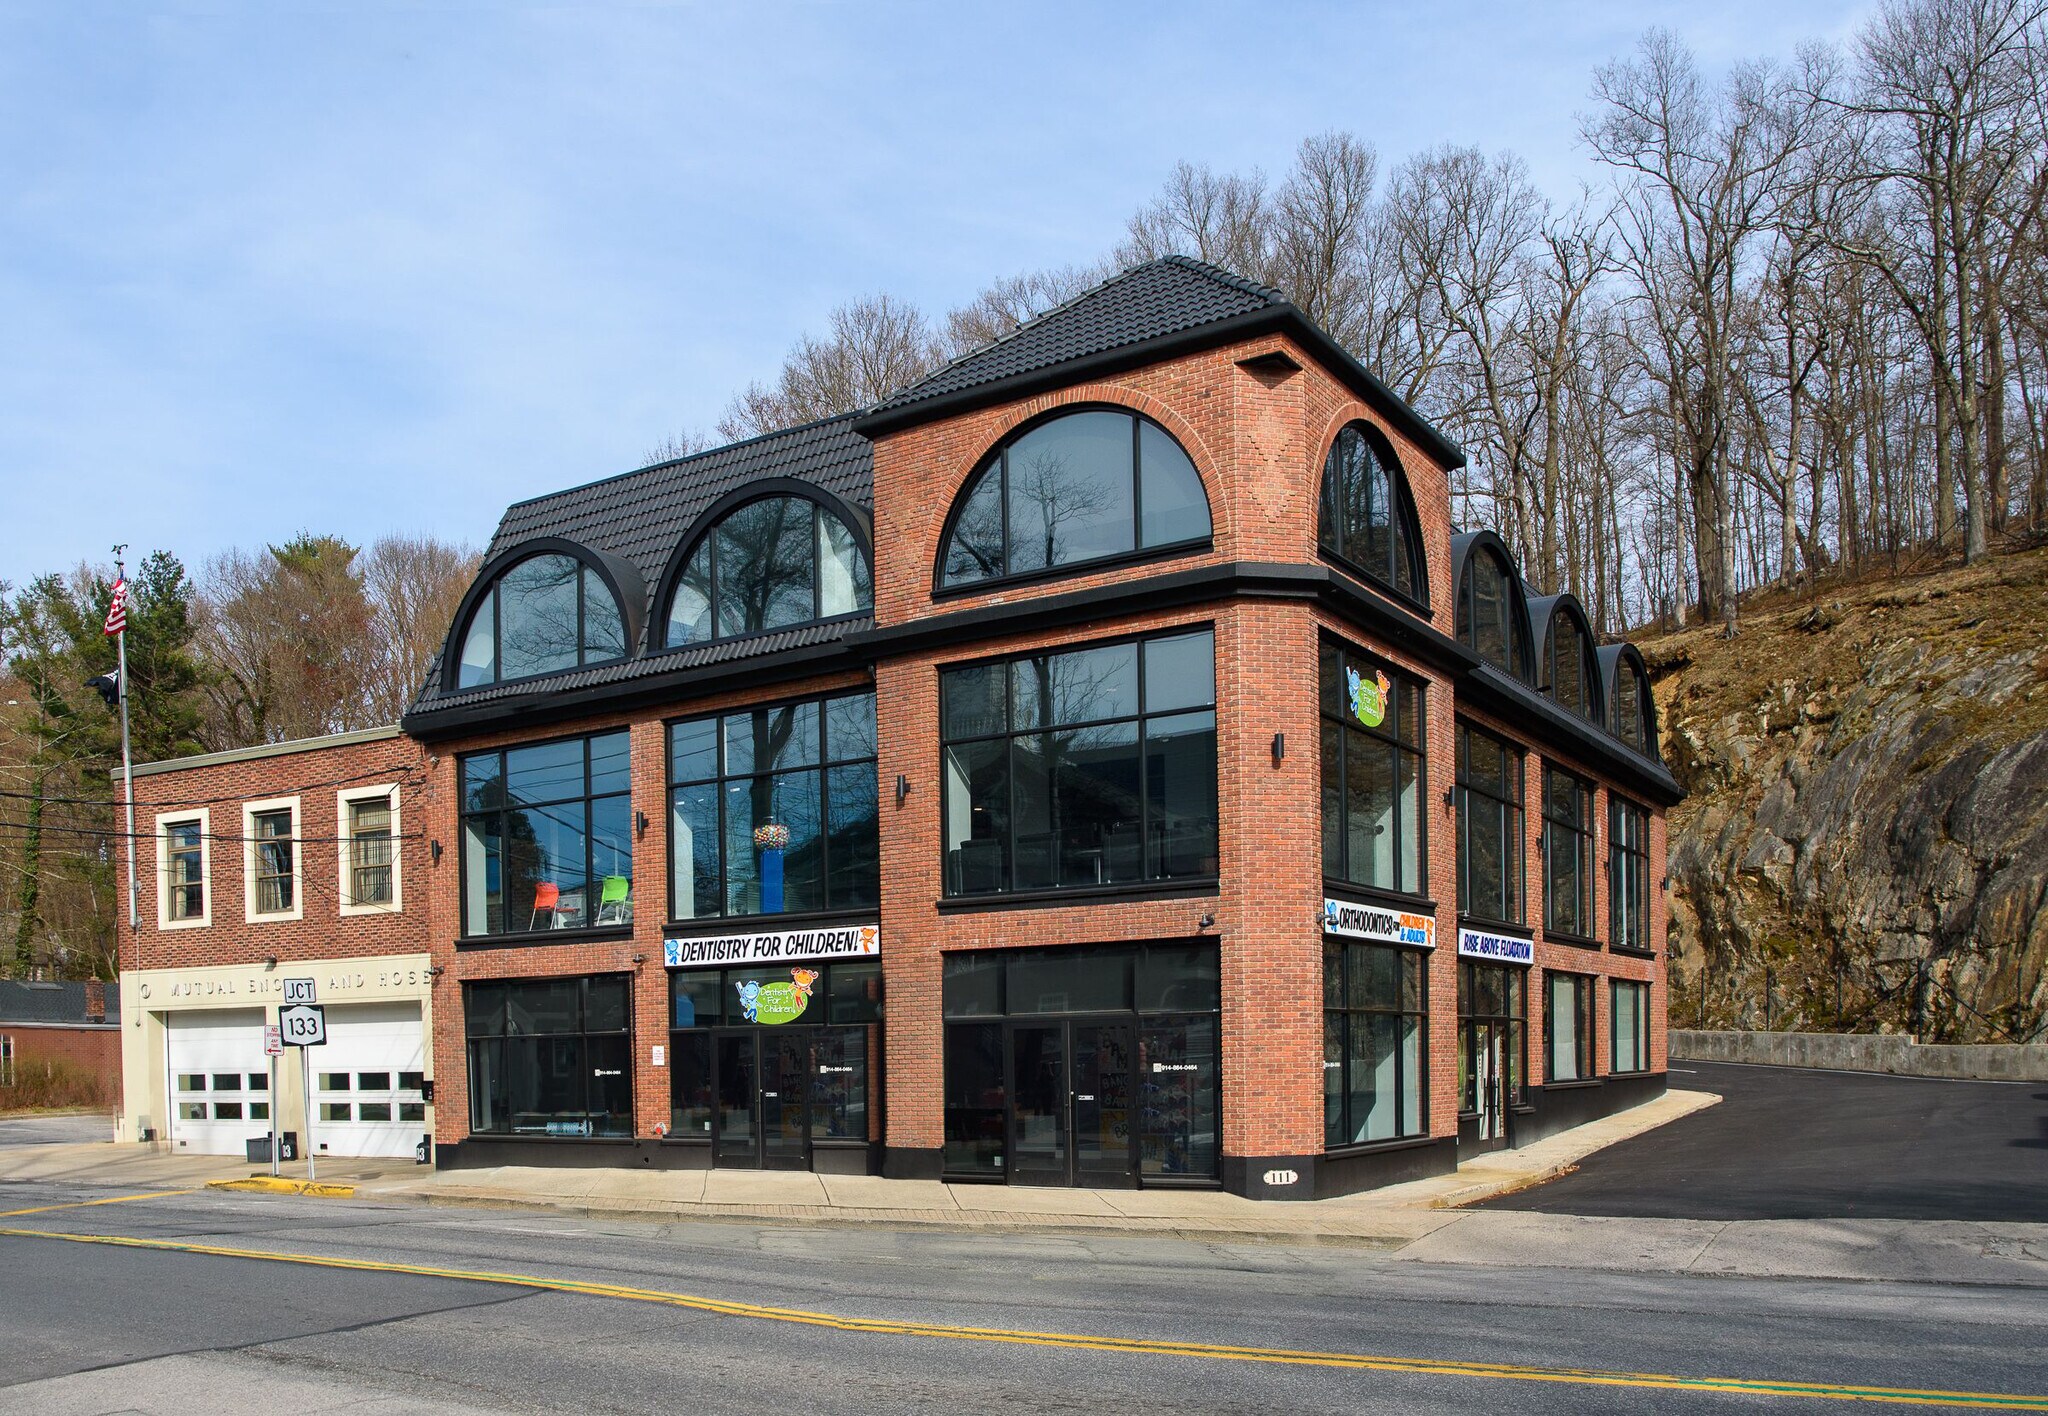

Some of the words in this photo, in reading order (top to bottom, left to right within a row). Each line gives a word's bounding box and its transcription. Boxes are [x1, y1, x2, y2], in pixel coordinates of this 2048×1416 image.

[1339, 907, 1393, 936] ORTHODONTICS
[1400, 913, 1425, 930] CHILDREN
[1400, 927, 1406, 941] &
[1406, 928, 1426, 944] ADULTS
[681, 938, 751, 962] DENTISTRY
[753, 934, 780, 957] FOR
[785, 930, 859, 955] CHILDREN!
[1463, 933, 1480, 953] RISE
[1479, 936, 1500, 956] ABOVE
[171, 980, 235, 997] MUTUAL
[329, 973, 364, 989] AND
[380, 970, 431, 987] HOSE
[287, 982, 313, 999] JCT
[760, 987, 795, 1000] Dentistry
[767, 996, 780, 1004] For
[288, 1017, 317, 1036] 133
[1272, 1172, 1290, 1183] 111
